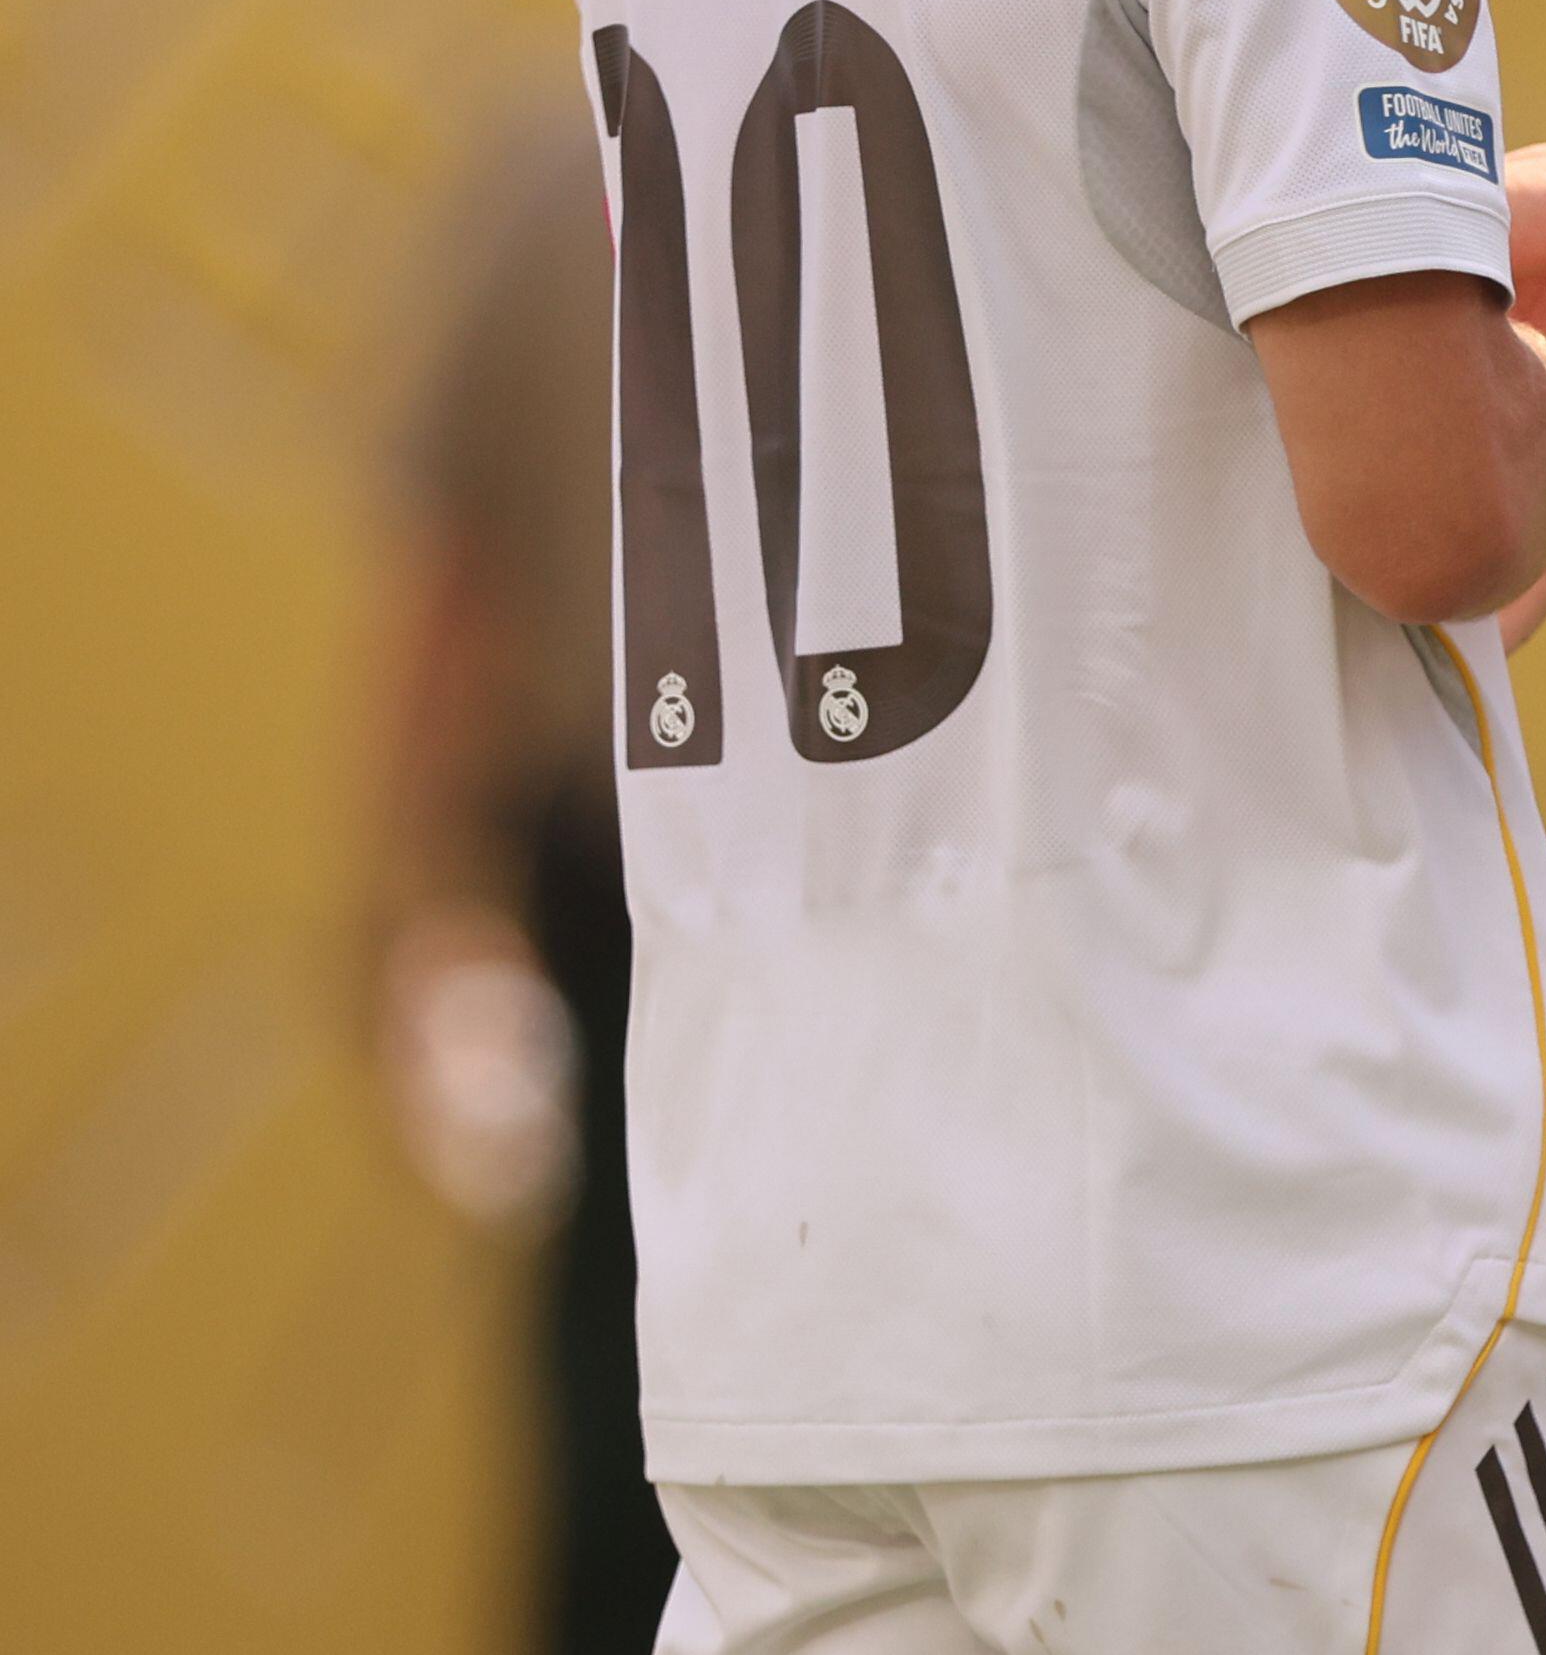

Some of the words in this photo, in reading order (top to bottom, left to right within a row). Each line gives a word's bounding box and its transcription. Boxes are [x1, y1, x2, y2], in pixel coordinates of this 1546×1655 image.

[1399, 15, 1444, 54] FIFA
[1382, 93, 1446, 128] FOOTBALL
[1444, 107, 1484, 142] UNITES
[1384, 120, 1421, 150] the
[1420, 124, 1461, 163] World
[593, 0, 993, 771] 10
